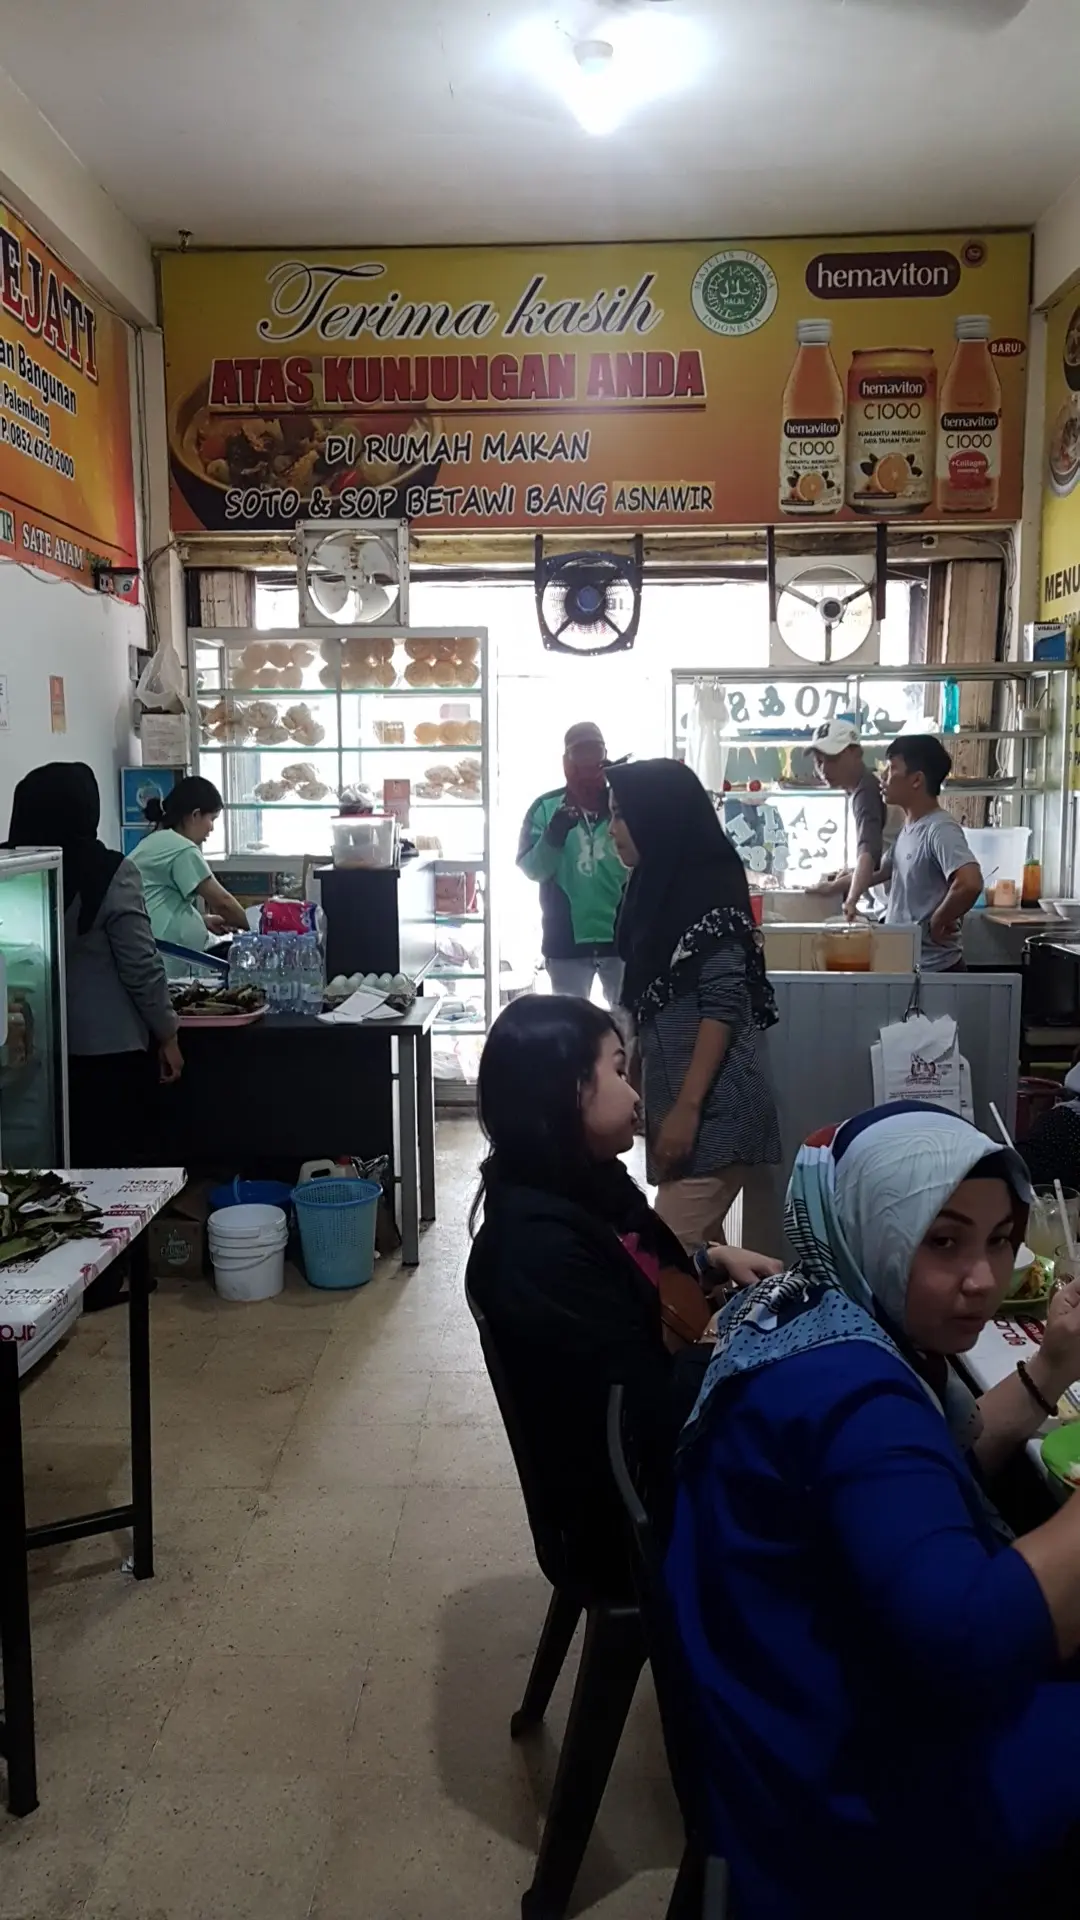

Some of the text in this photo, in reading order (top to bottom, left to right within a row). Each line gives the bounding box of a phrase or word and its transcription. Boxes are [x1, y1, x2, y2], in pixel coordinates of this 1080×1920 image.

[817, 262, 949, 289] hemaviton
[259, 261, 664, 340] Terima kasih
[702, 314, 762, 333] INDONESIA
[991, 342, 1022, 355] BARU!
[18, 343, 77, 414] Bangunan
[210, 350, 706, 405] ATAS KUNJUNGAN ANDA
[862, 381, 923, 395] hemaviton
[4, 382, 50, 438] Palembang
[864, 402, 921, 420] C1000
[943, 416, 997, 428] hemaviton
[786, 422, 838, 434] hemaviton
[946, 433, 993, 449] C1000
[326, 430, 590, 464] DI RUMAH MAKAN
[788, 440, 835, 456] C1000
[55, 449, 75, 479] 2000
[225, 482, 713, 519] SOTO & SOP BETAWI BANG ASNAWIR
[22, 522, 52, 558] SATE
[54, 537, 84, 572] AYAM
[1045, 564, 1080, 603] MENU
